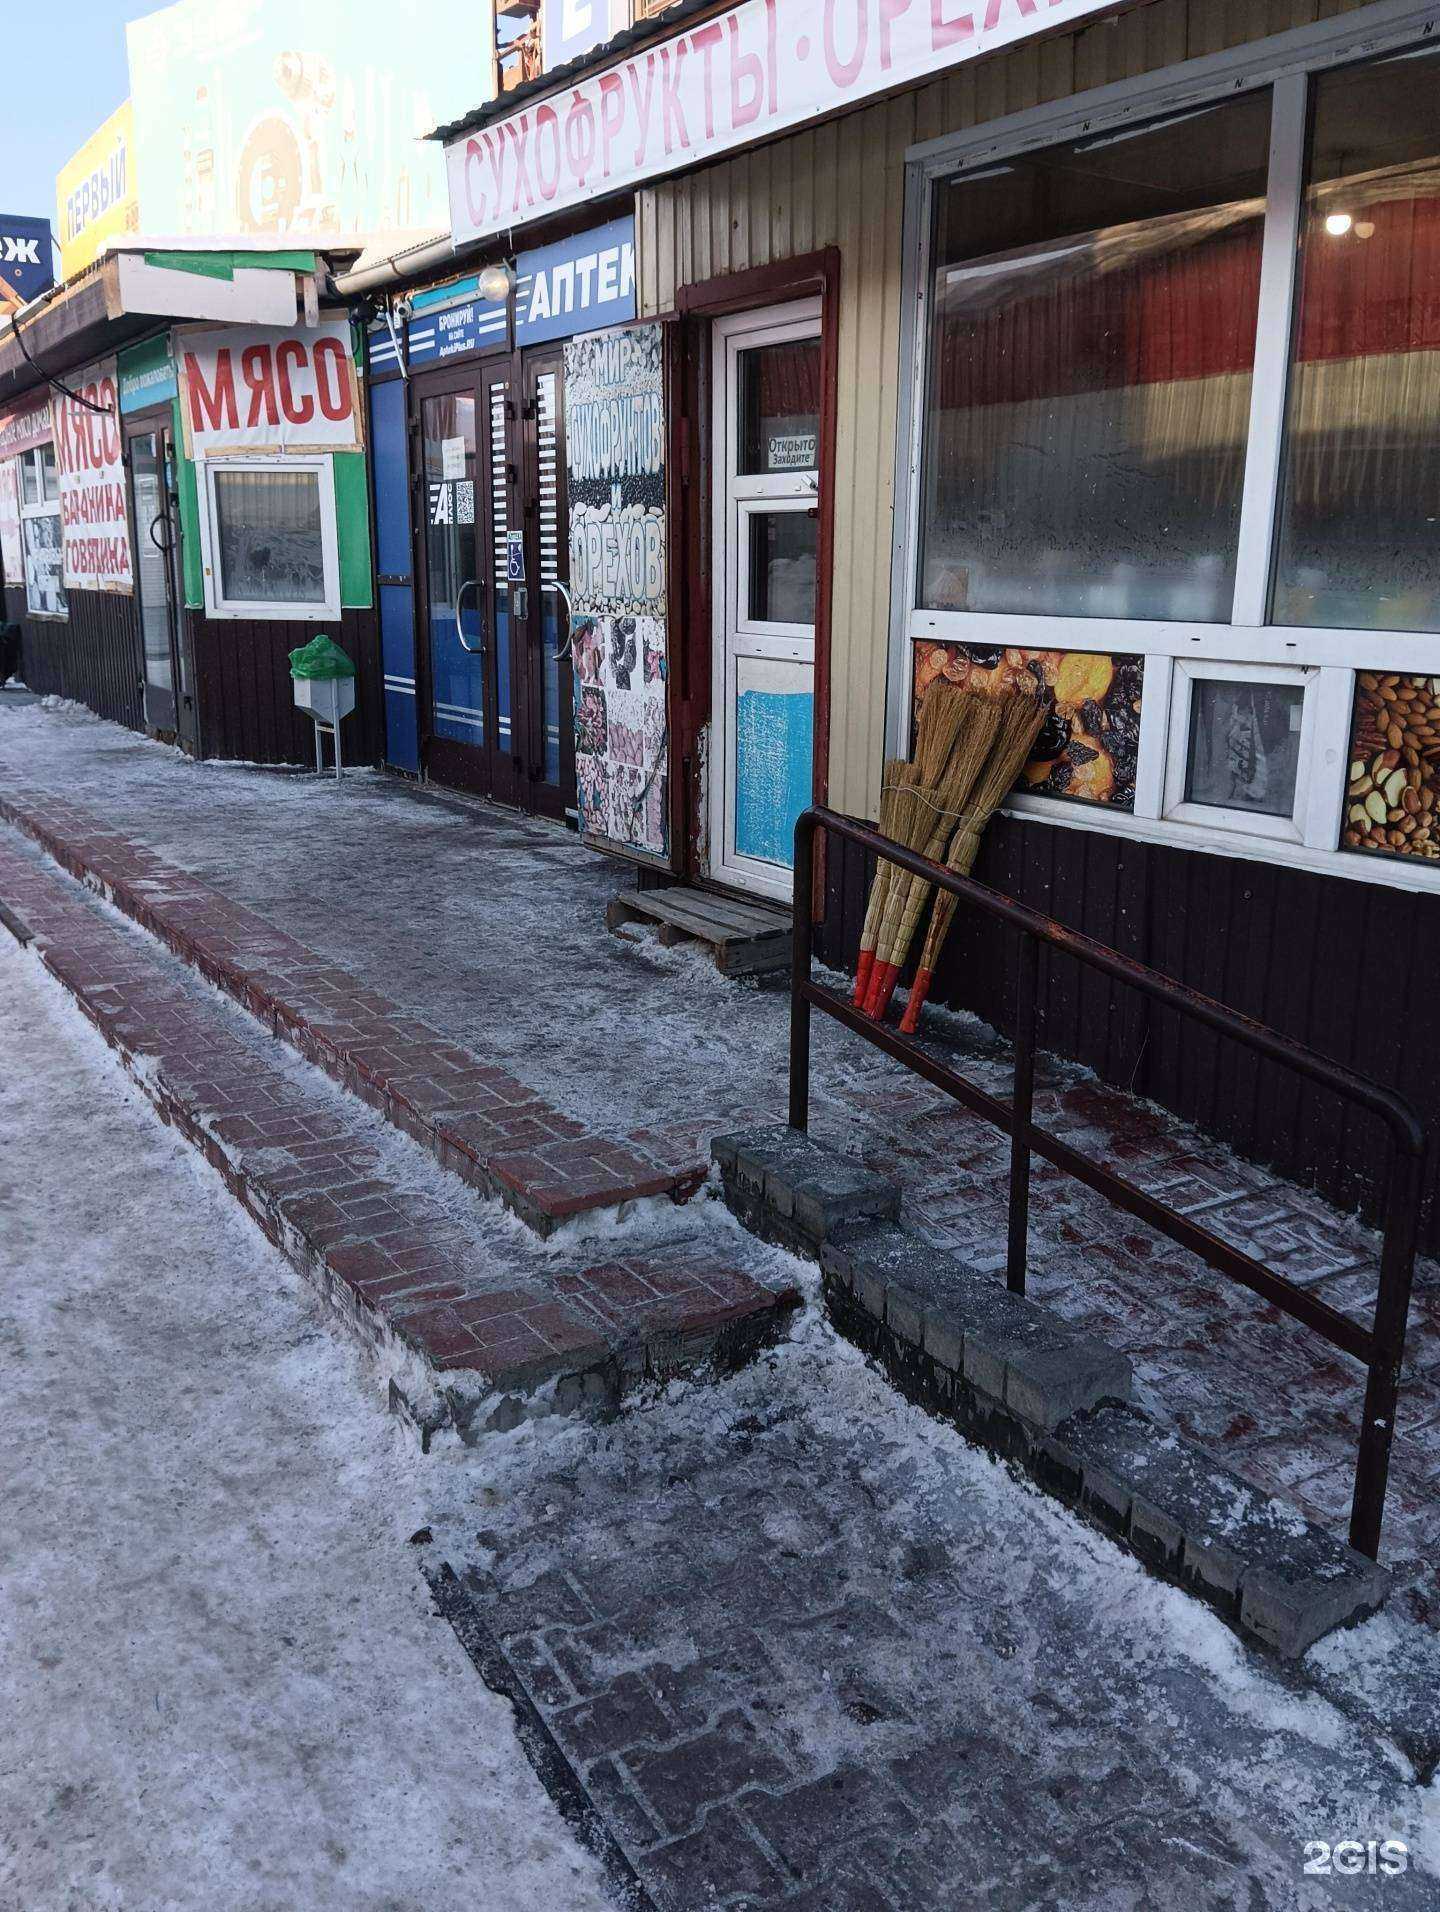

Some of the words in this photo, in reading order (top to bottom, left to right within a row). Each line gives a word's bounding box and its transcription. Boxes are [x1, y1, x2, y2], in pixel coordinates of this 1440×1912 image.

[464, 0, 778, 228] СУХОФРУКТЫ
[67, 136, 126, 242] ПЕРВЫЙ
[0, 236, 41, 264] Ж
[527, 242, 636, 323] АПТЕК
[183, 336, 352, 433] МЯСО
[594, 337, 632, 387] МИР
[571, 391, 661, 482] СУХОФРУКТОВ
[769, 438, 816, 454] Открыто
[773, 453, 810, 466] Заходите
[573, 520, 662, 600] ОРЕХОВ
